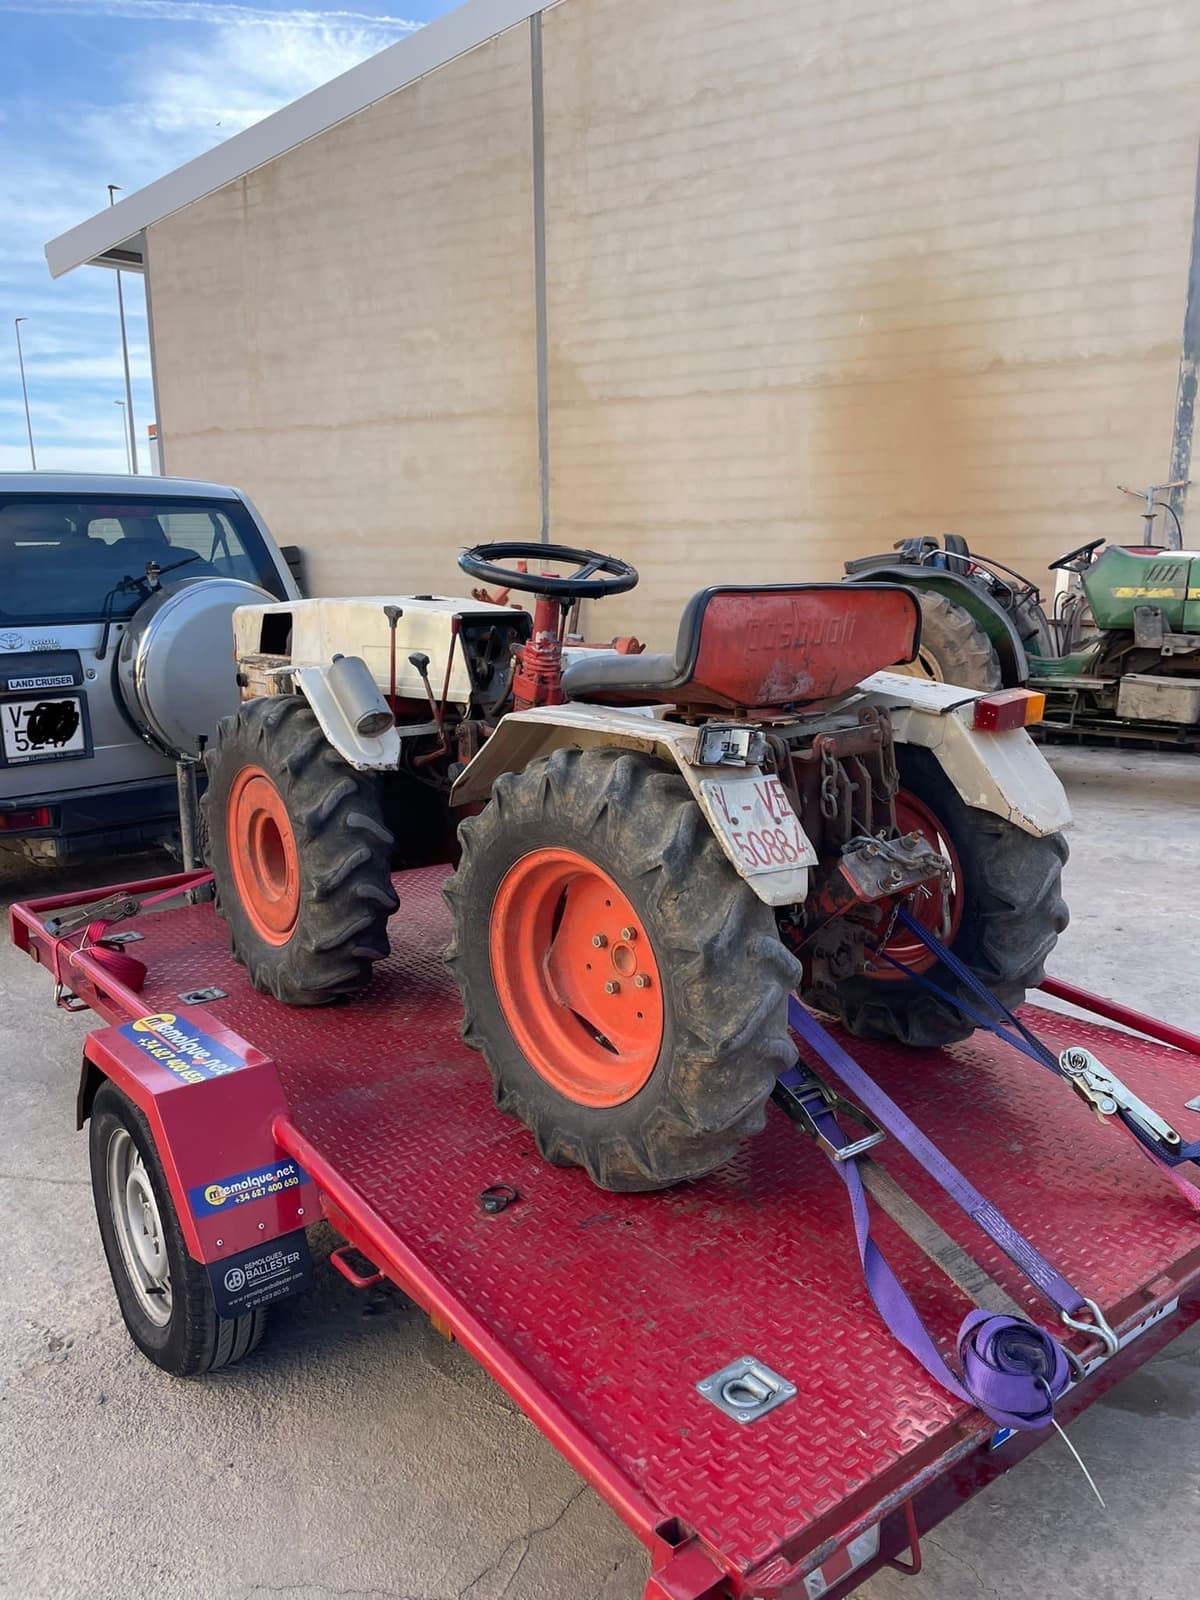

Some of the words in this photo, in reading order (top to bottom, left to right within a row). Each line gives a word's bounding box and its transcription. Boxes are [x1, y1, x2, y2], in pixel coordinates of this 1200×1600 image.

[10, 679, 34, 689] LAND
[35, 676, 73, 687] CRUISER
[234, 1193, 251, 1204] +34
[251, 1187, 266, 1199] 627
[267, 1182, 283, 1193] 400
[284, 1176, 299, 1188] 650
[244, 1250, 284, 1271] REMOLQUES
[245, 1251, 300, 1281] BALLESTER
